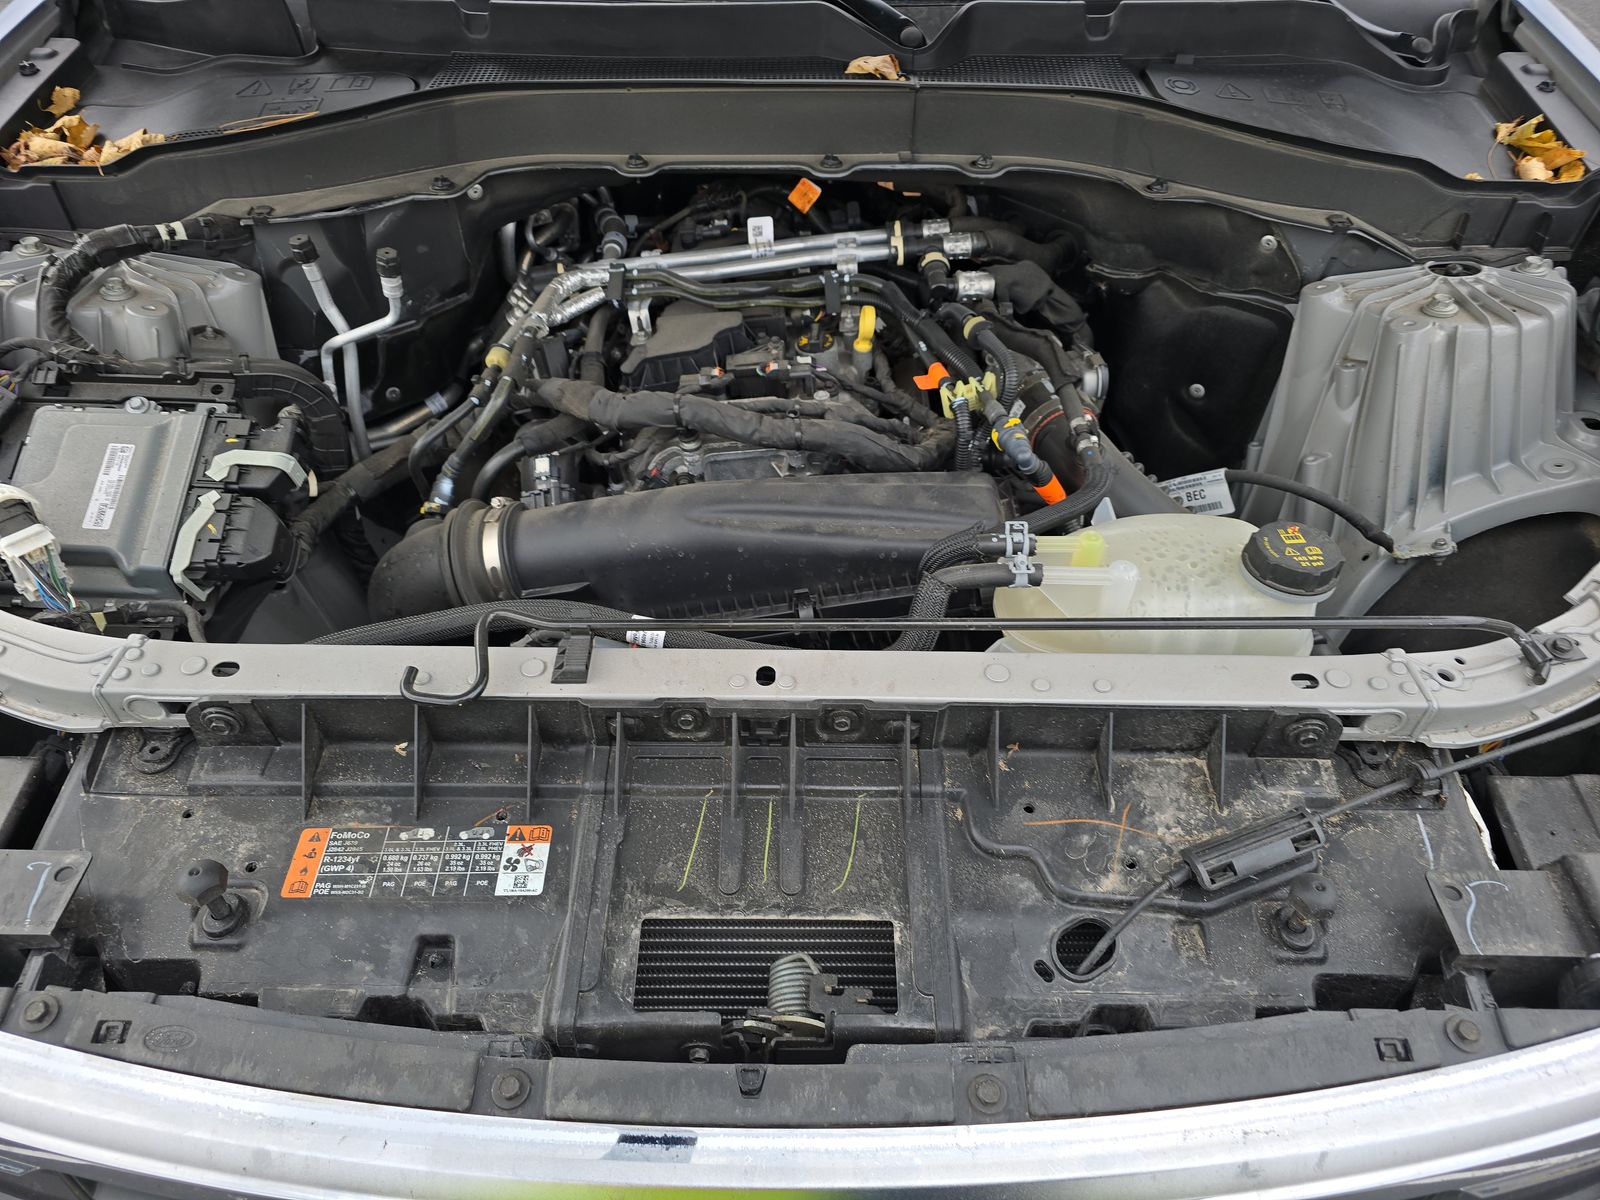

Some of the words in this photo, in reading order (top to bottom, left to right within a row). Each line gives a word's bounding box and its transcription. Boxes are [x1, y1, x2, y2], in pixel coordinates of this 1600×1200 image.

[1185, 489, 1206, 502] BEC
[330, 831, 370, 839] FoMoCo
[323, 856, 361, 864] R-1234yf
[430, 854, 439, 862] kg
[462, 853, 471, 861] kg
[492, 853, 501, 861] kg
[320, 864, 345, 873] (GWP
[345, 864, 355, 873] 4)
